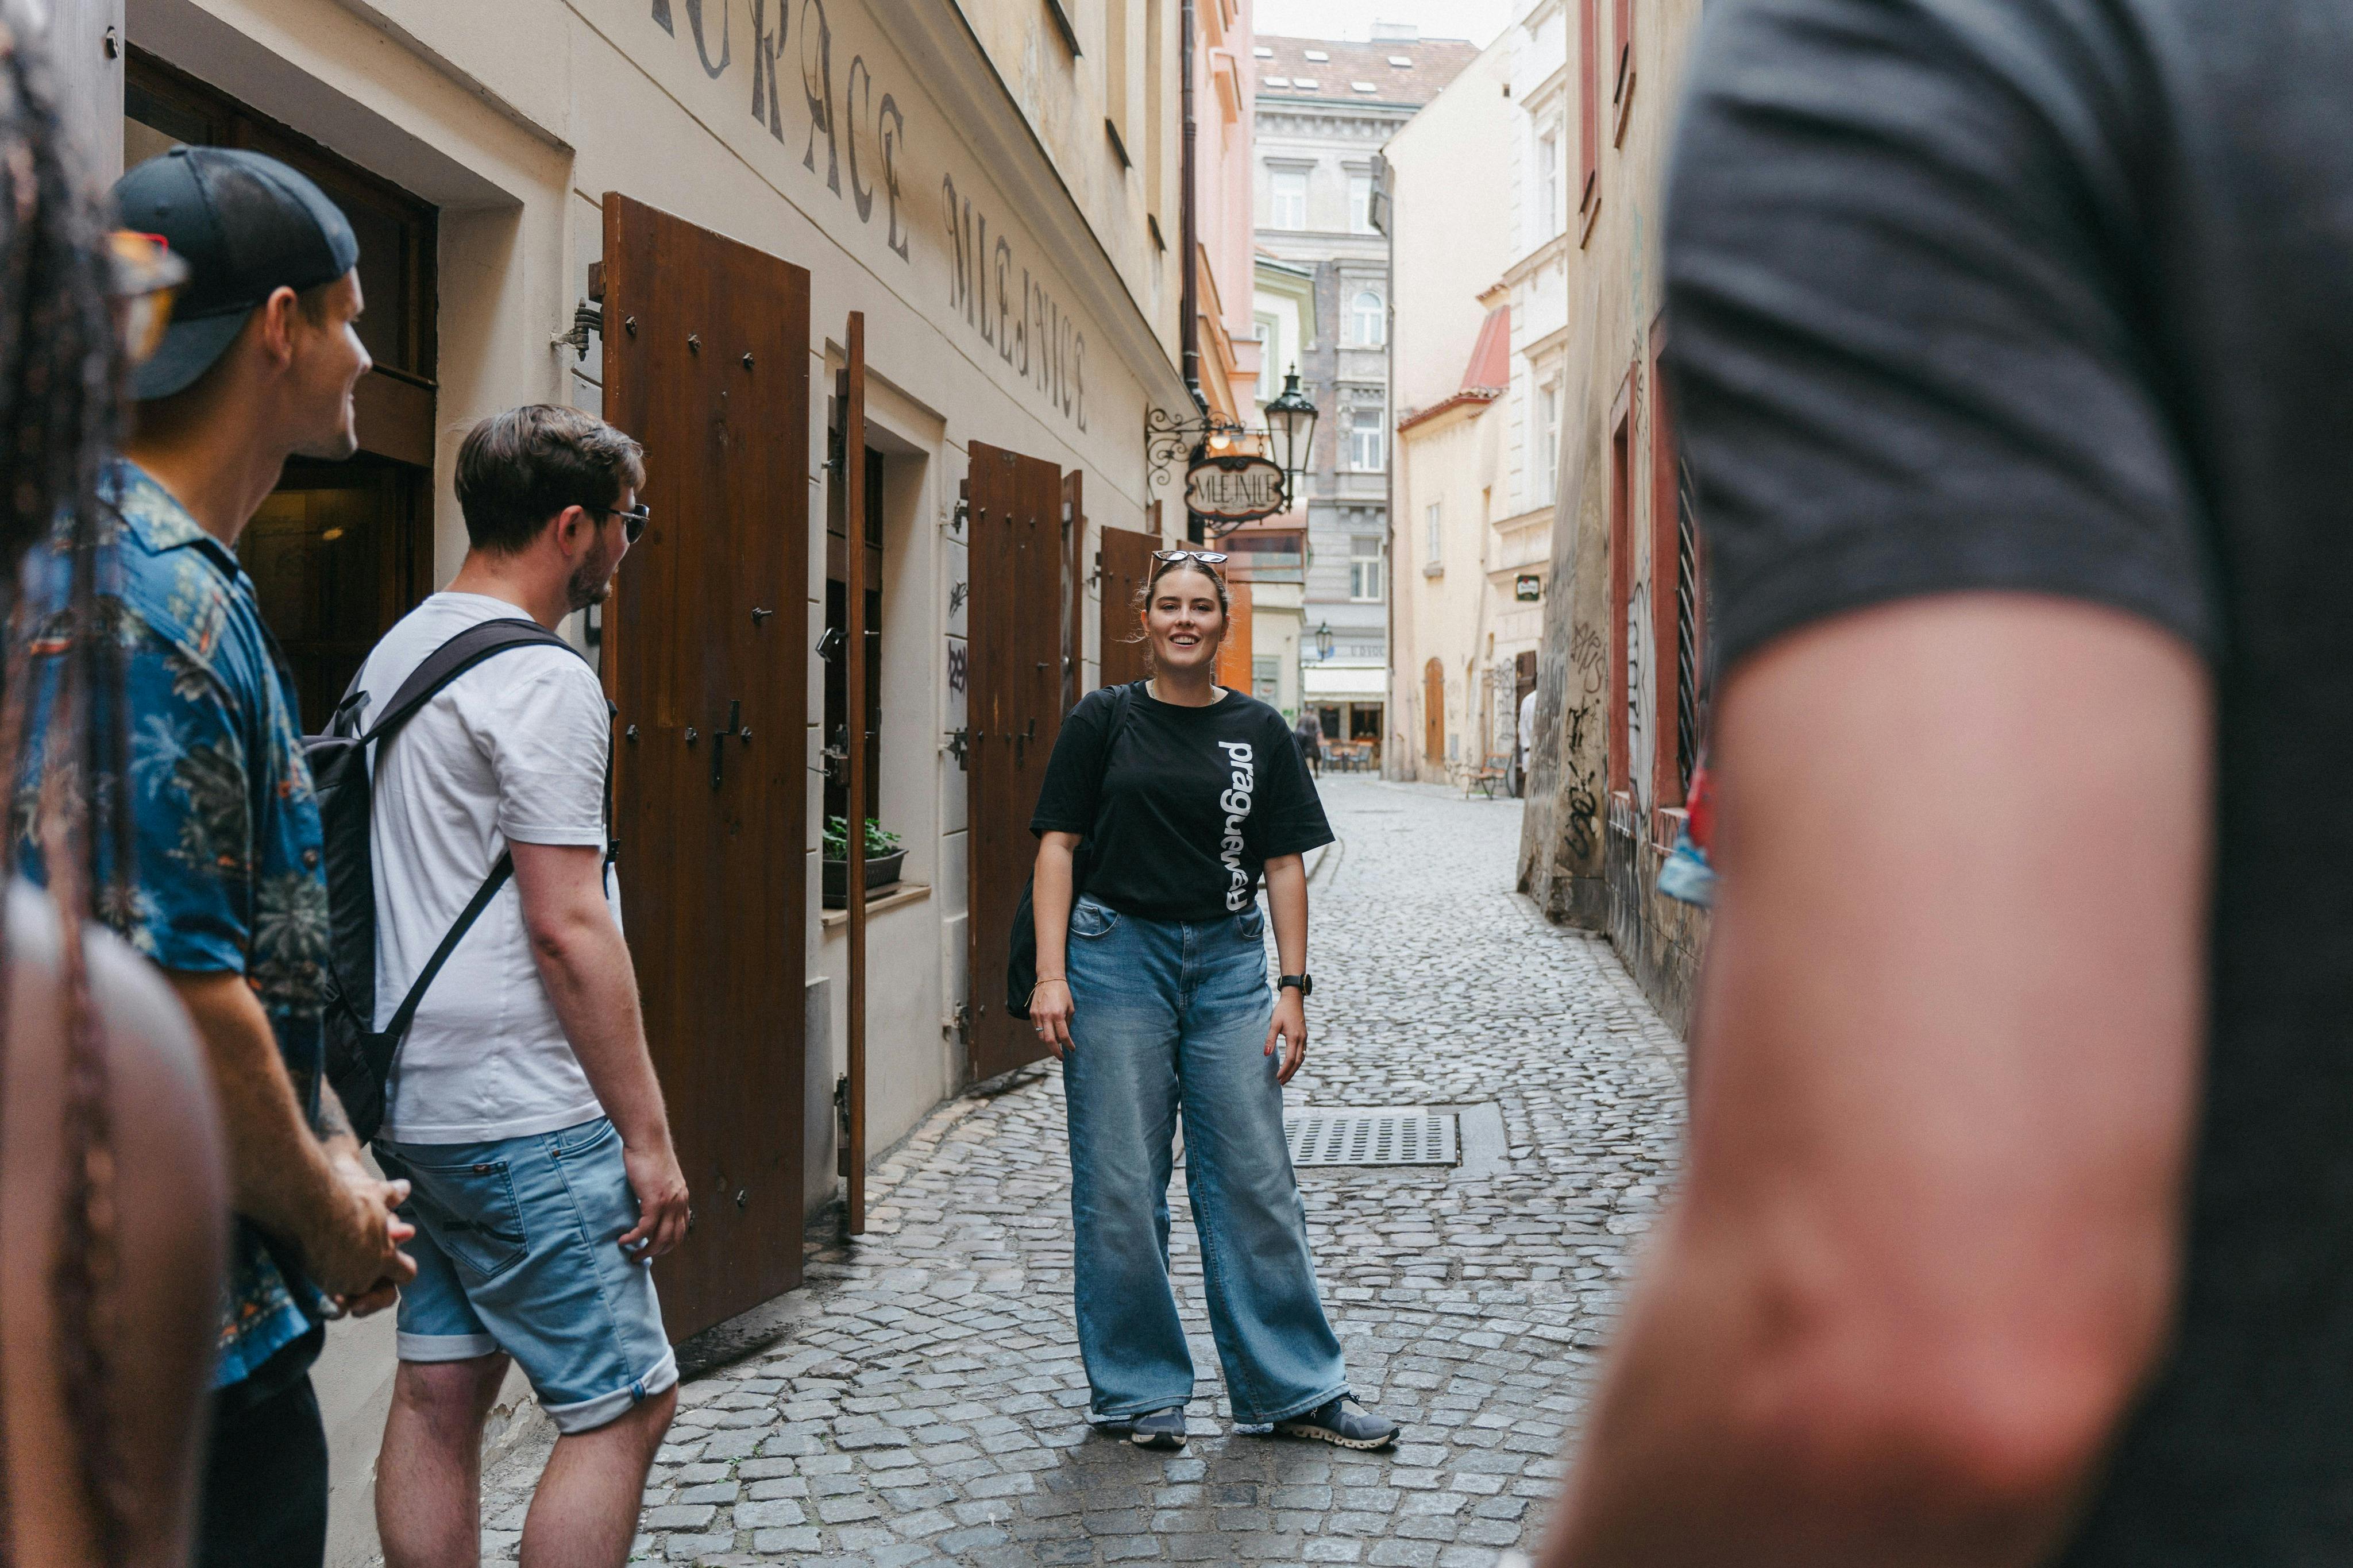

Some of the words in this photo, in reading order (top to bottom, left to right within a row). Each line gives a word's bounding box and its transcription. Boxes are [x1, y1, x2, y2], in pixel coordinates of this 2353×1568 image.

[942, 172, 1086, 434] MLEJNICE
[1195, 474, 1275, 504] MLEJNICE
[1218, 741, 1254, 912] pragueway
